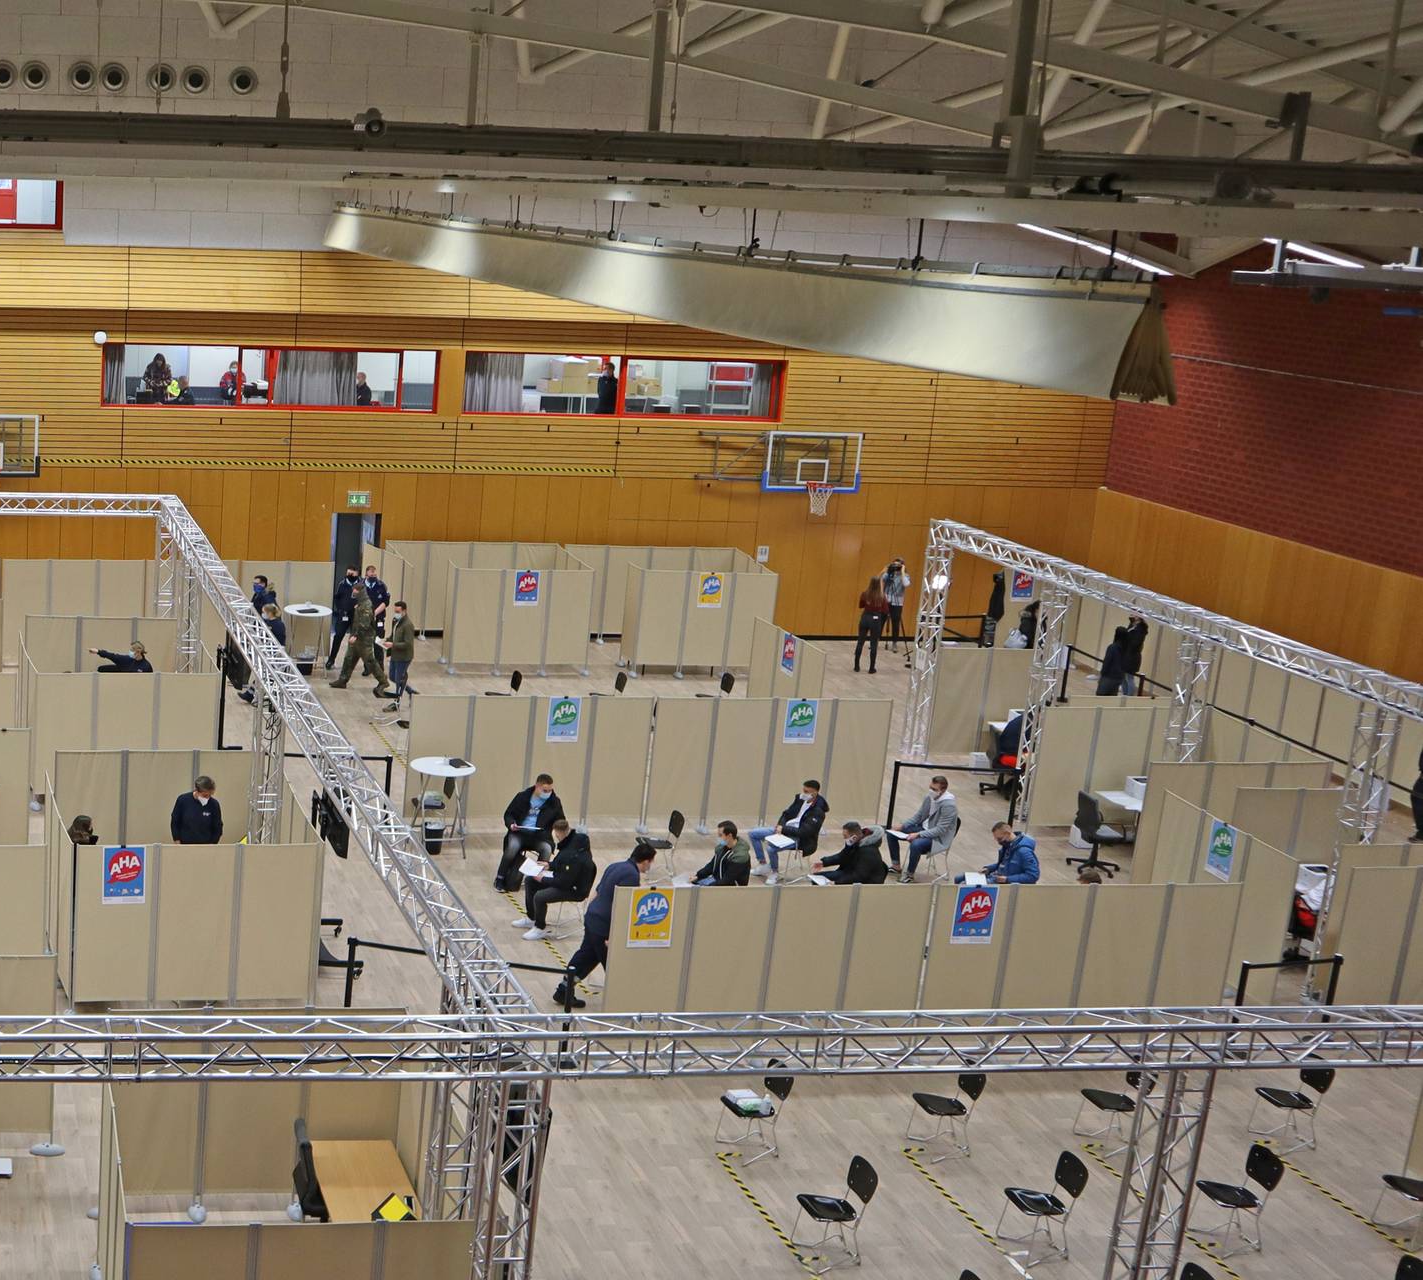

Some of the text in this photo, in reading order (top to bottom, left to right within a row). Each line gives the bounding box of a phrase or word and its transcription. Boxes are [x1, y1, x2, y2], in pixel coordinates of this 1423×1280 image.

[519, 576, 537, 589] AHA
[703, 578, 720, 591] AHA
[553, 703, 578, 720] AHA
[791, 706, 814, 721] AHA
[1214, 833, 1233, 847] AHA
[110, 855, 141, 876] AHA
[637, 897, 669, 917] AHA
[961, 895, 992, 915] AHA
